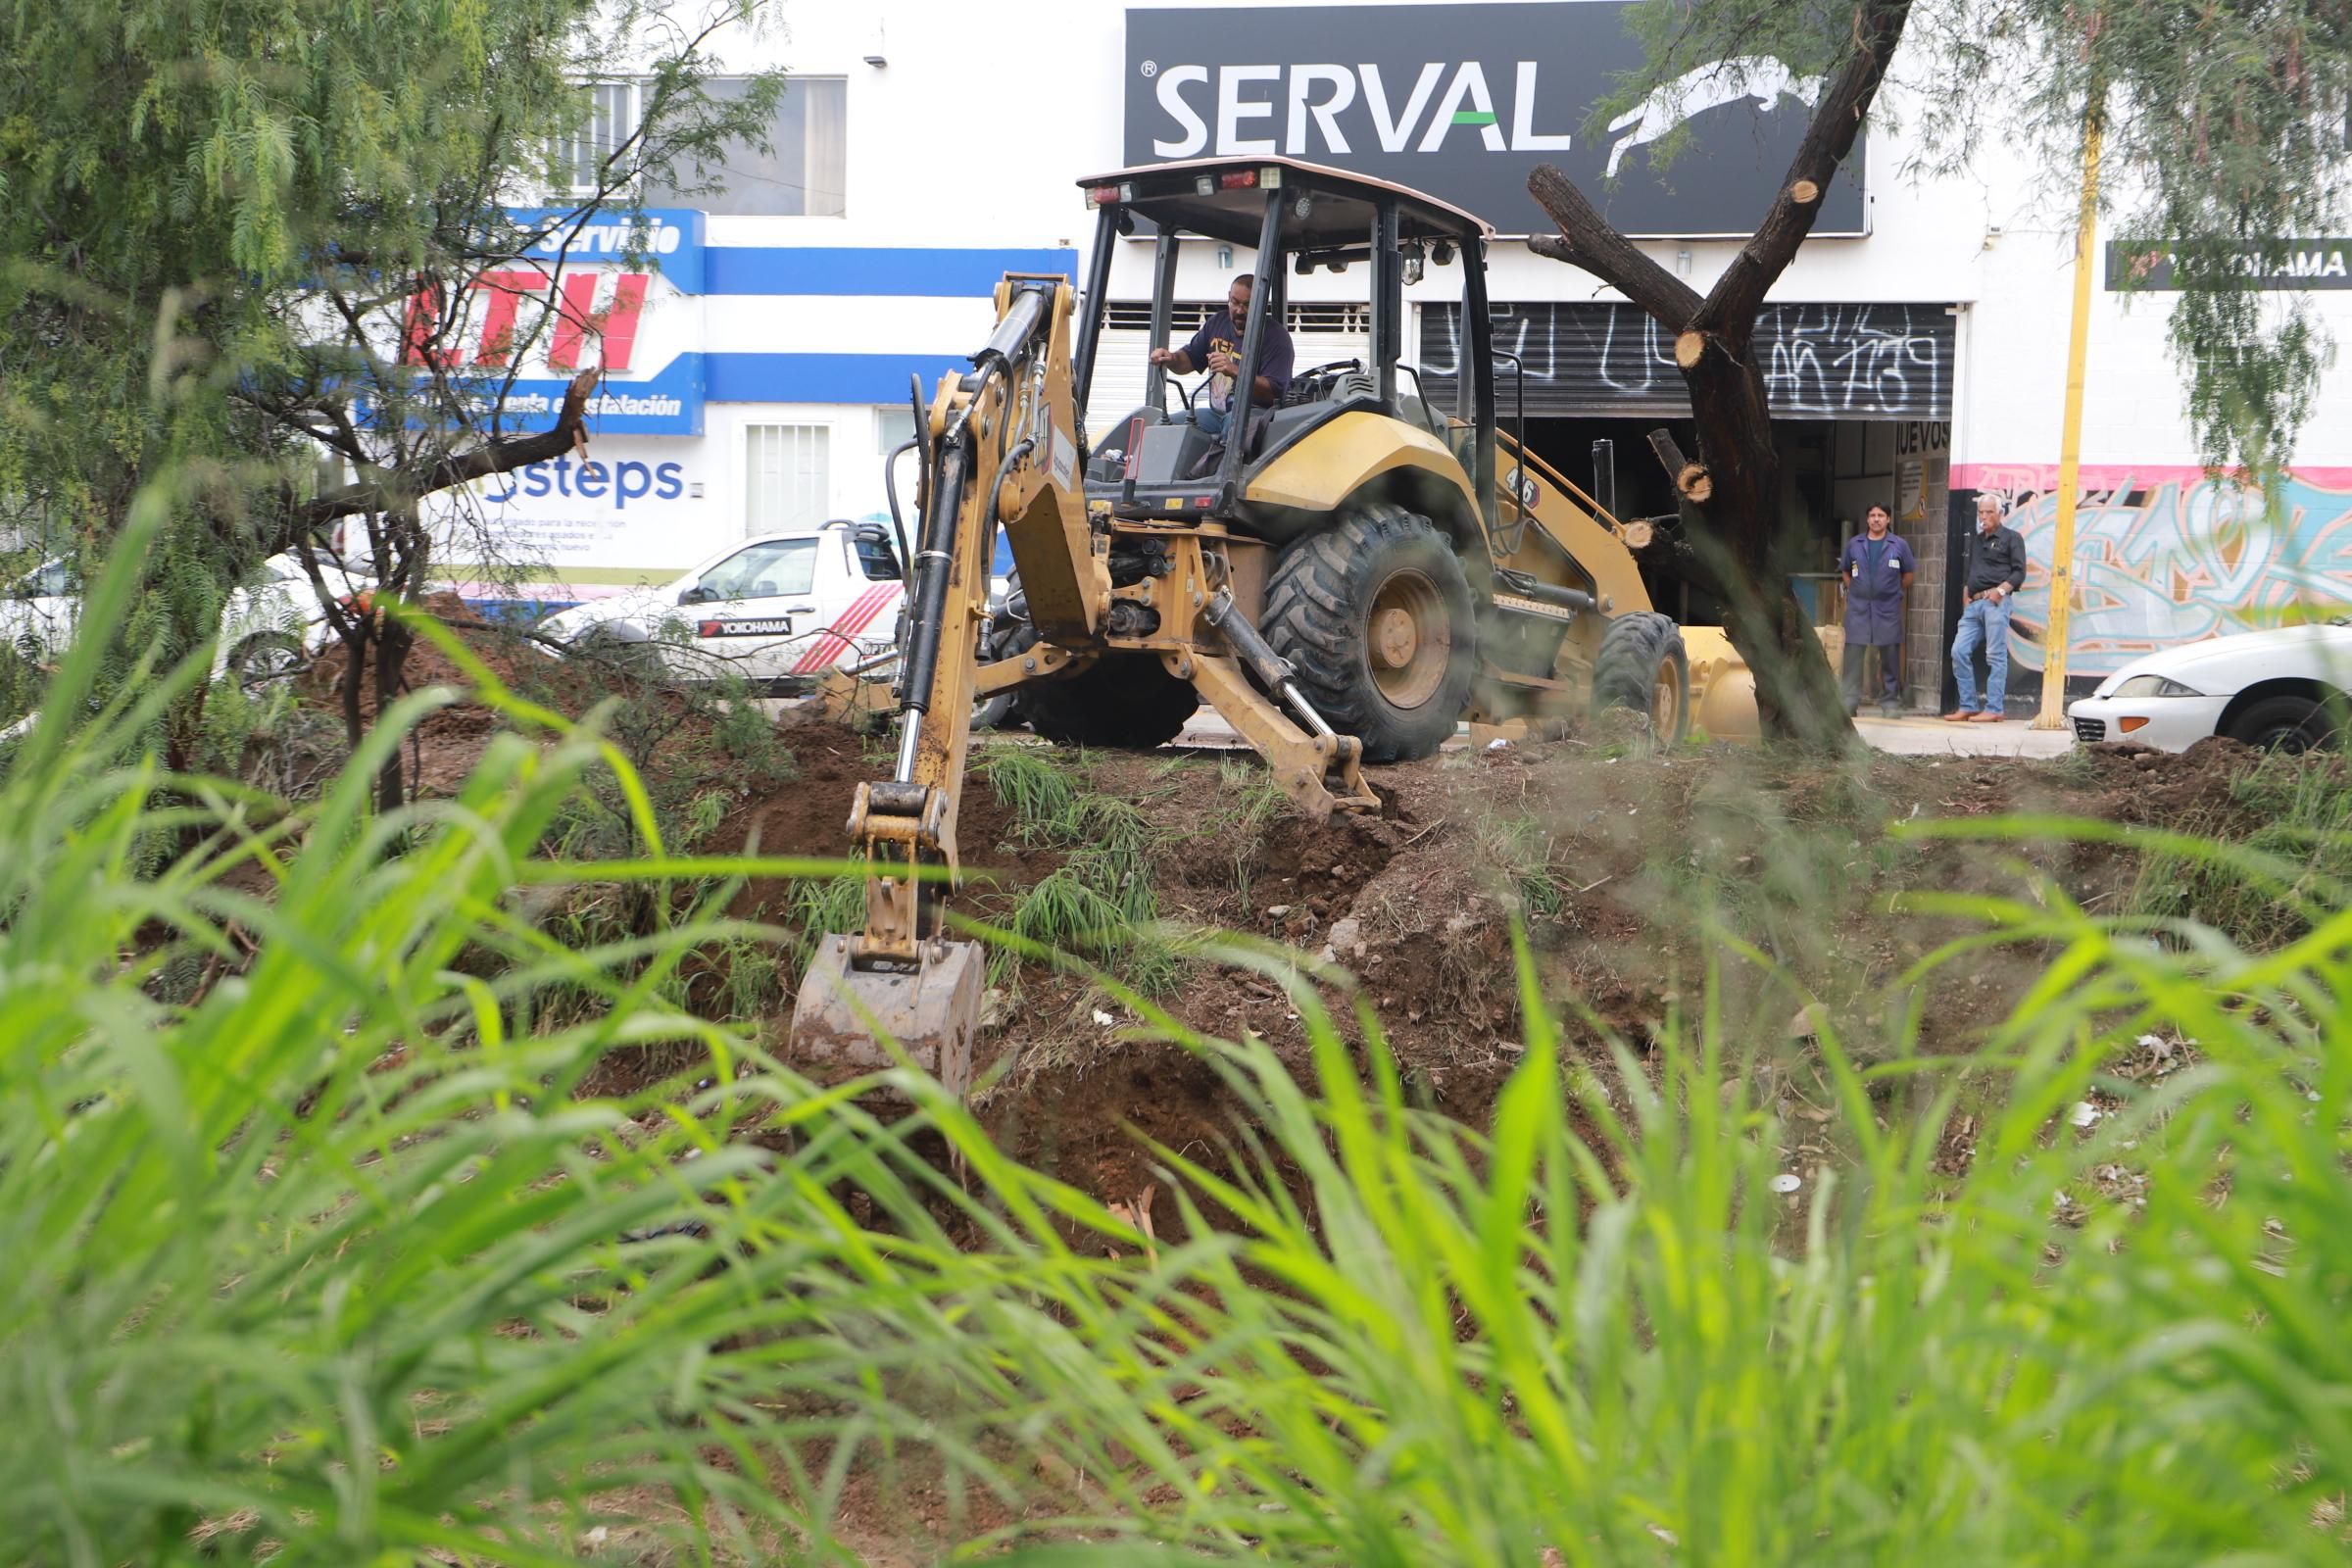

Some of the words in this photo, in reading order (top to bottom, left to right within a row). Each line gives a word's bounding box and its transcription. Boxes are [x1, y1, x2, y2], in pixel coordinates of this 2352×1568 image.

[1153, 62, 1571, 158] SERVAL
[540, 217, 680, 254] Serviio
[402, 271, 651, 369] LTH
[582, 394, 682, 416] stalación
[721, 620, 790, 634] YOKOHAMA
